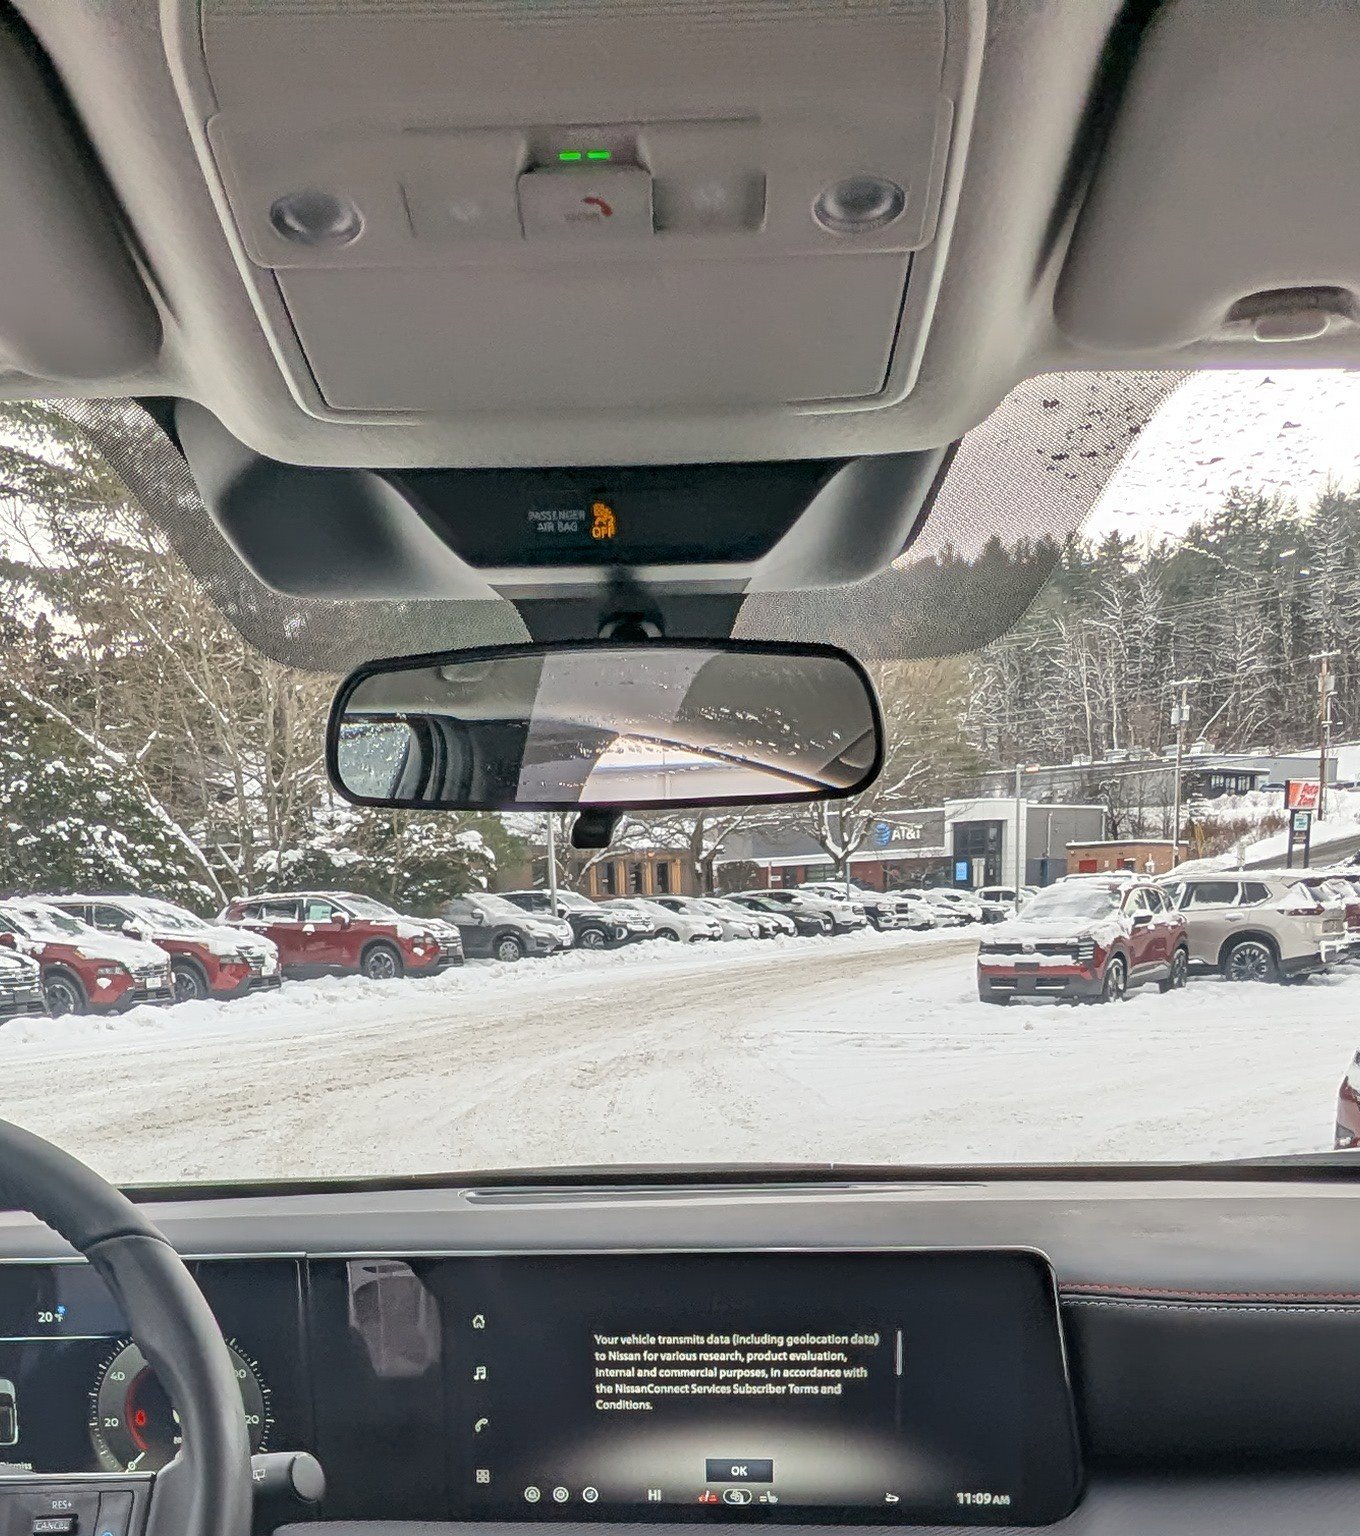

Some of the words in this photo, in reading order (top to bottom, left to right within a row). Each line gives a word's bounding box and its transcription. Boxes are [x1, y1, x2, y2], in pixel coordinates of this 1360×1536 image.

[527, 510, 586, 521] PASSENGER
[537, 521, 554, 532] AIR
[557, 521, 578, 533] BAG
[891, 825, 923, 841] AT&T
[38, 1311, 53, 1323] 20
[594, 1334, 619, 1345] Your
[620, 1333, 656, 1345] vehicle
[657, 1333, 705, 1345] transmits
[706, 1333, 730, 1345] data
[732, 1332, 784, 1347] (including
[787, 1333, 848, 1347] geolocation
[850, 1332, 880, 1346] data)
[594, 1351, 606, 1361] to
[608, 1351, 641, 1361] Nissan
[643, 1350, 658, 1361] for
[660, 1351, 697, 1361] various
[699, 1350, 744, 1363] research,
[746, 1350, 788, 1363] product
[789, 1350, 848, 1363] evaluation,
[110, 1371, 126, 1381] 40
[595, 1366, 635, 1377] internal
[637, 1367, 657, 1377] and
[659, 1366, 717, 1378] commercial
[720, 1368, 768, 1379] purposes,
[770, 1367, 781, 1377] in
[783, 1367, 842, 1378] accordance
[843, 1366, 868, 1378] with
[595, 1383, 613, 1394] the
[615, 1383, 690, 1394] NissanConnect
[691, 1383, 731, 1394] Services
[732, 1383, 786, 1394] Subscriber
[788, 1383, 819, 1394] Terms
[820, 1383, 842, 1394] and
[595, 1399, 653, 1410] Conditions.
[104, 1417, 119, 1427] 20
[128, 1461, 136, 1471] 0
[730, 1466, 748, 1476] OK
[648, 1489, 662, 1501] HI
[956, 1492, 991, 1505] 11:09
[992, 1495, 1010, 1505] AM
[35, 1520, 69, 1531] CANCEL
